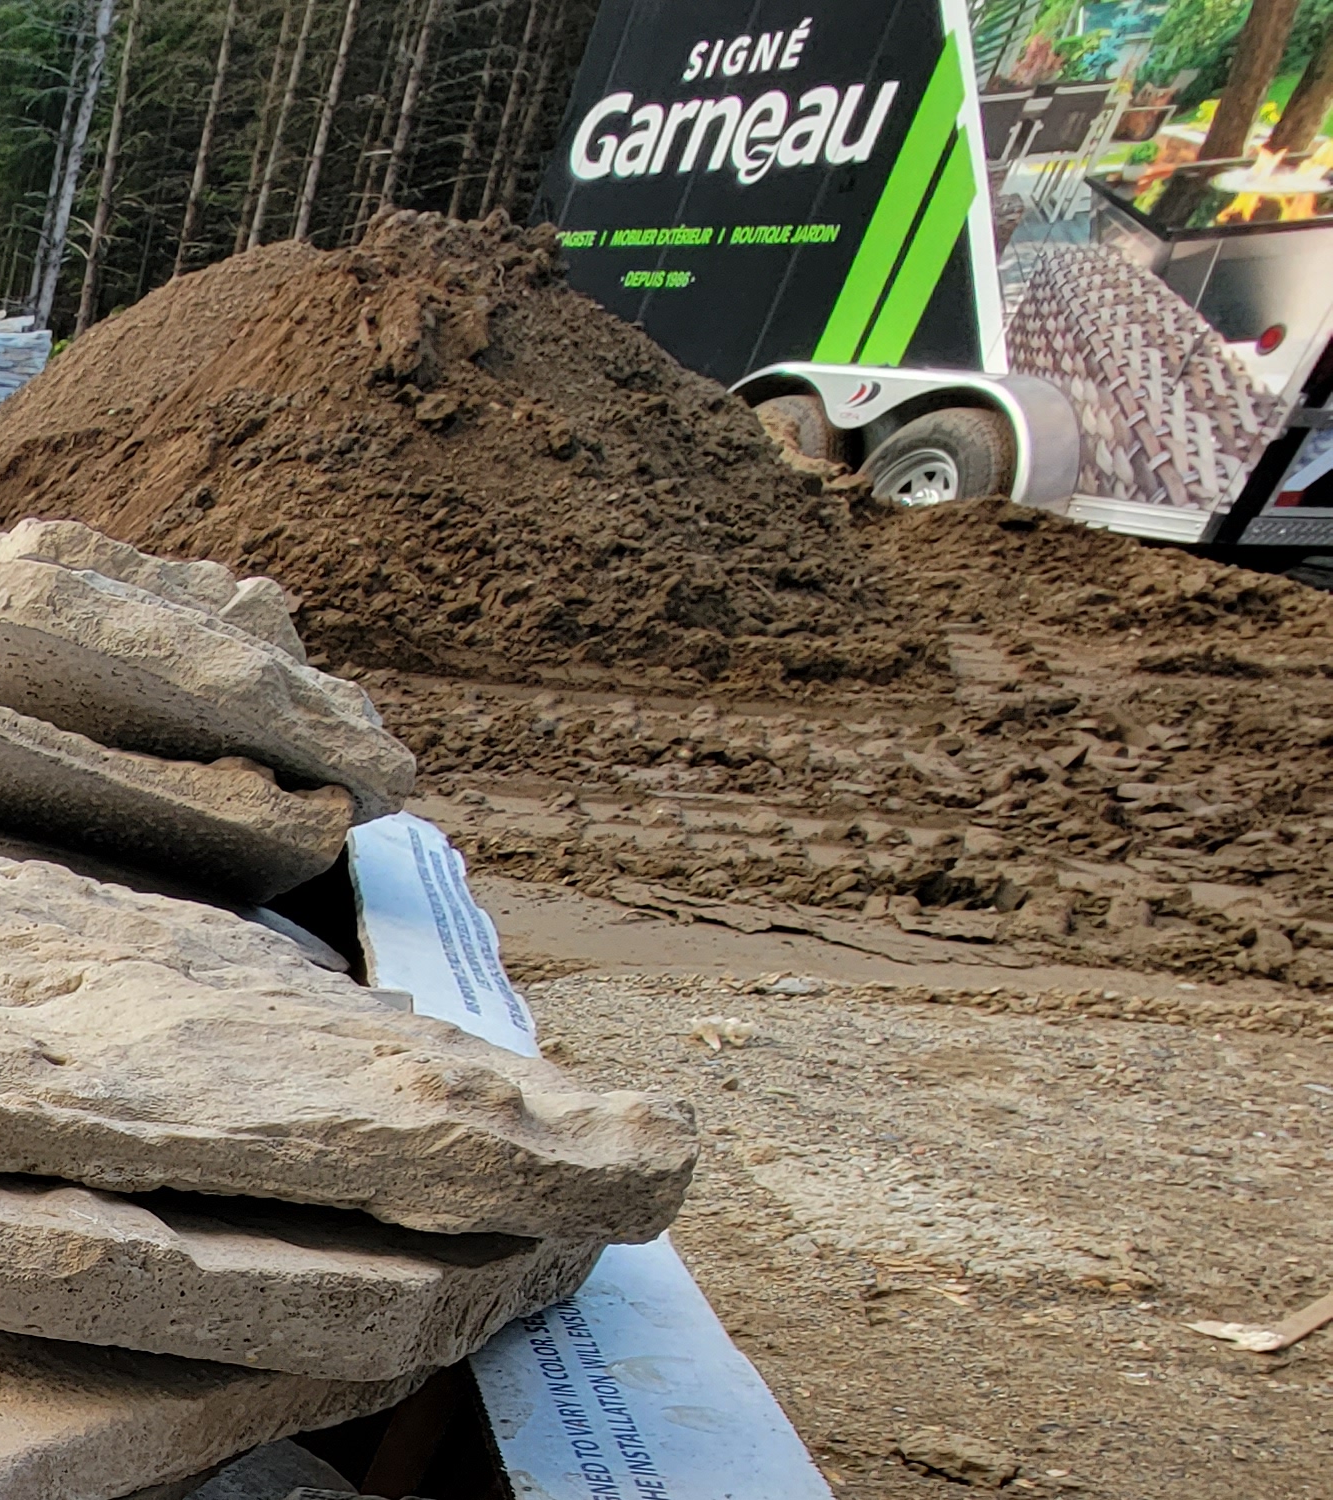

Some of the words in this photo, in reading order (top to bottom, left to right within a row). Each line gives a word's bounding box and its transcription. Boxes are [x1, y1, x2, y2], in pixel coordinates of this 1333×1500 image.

[683, 17, 813, 83] SIGNÉ
[569, 80, 901, 185] Garneau
[730, 225, 793, 245] BOUTIQUE
[790, 224, 841, 243] JARDIN
[529, 1336, 569, 1379] COLOR.
[572, 1341, 609, 1369] WILL
[546, 1382, 578, 1397] IN
[553, 1399, 593, 1435] VARY
[586, 1374, 659, 1476] INSTALLATION
[570, 1439, 604, 1458] TO
